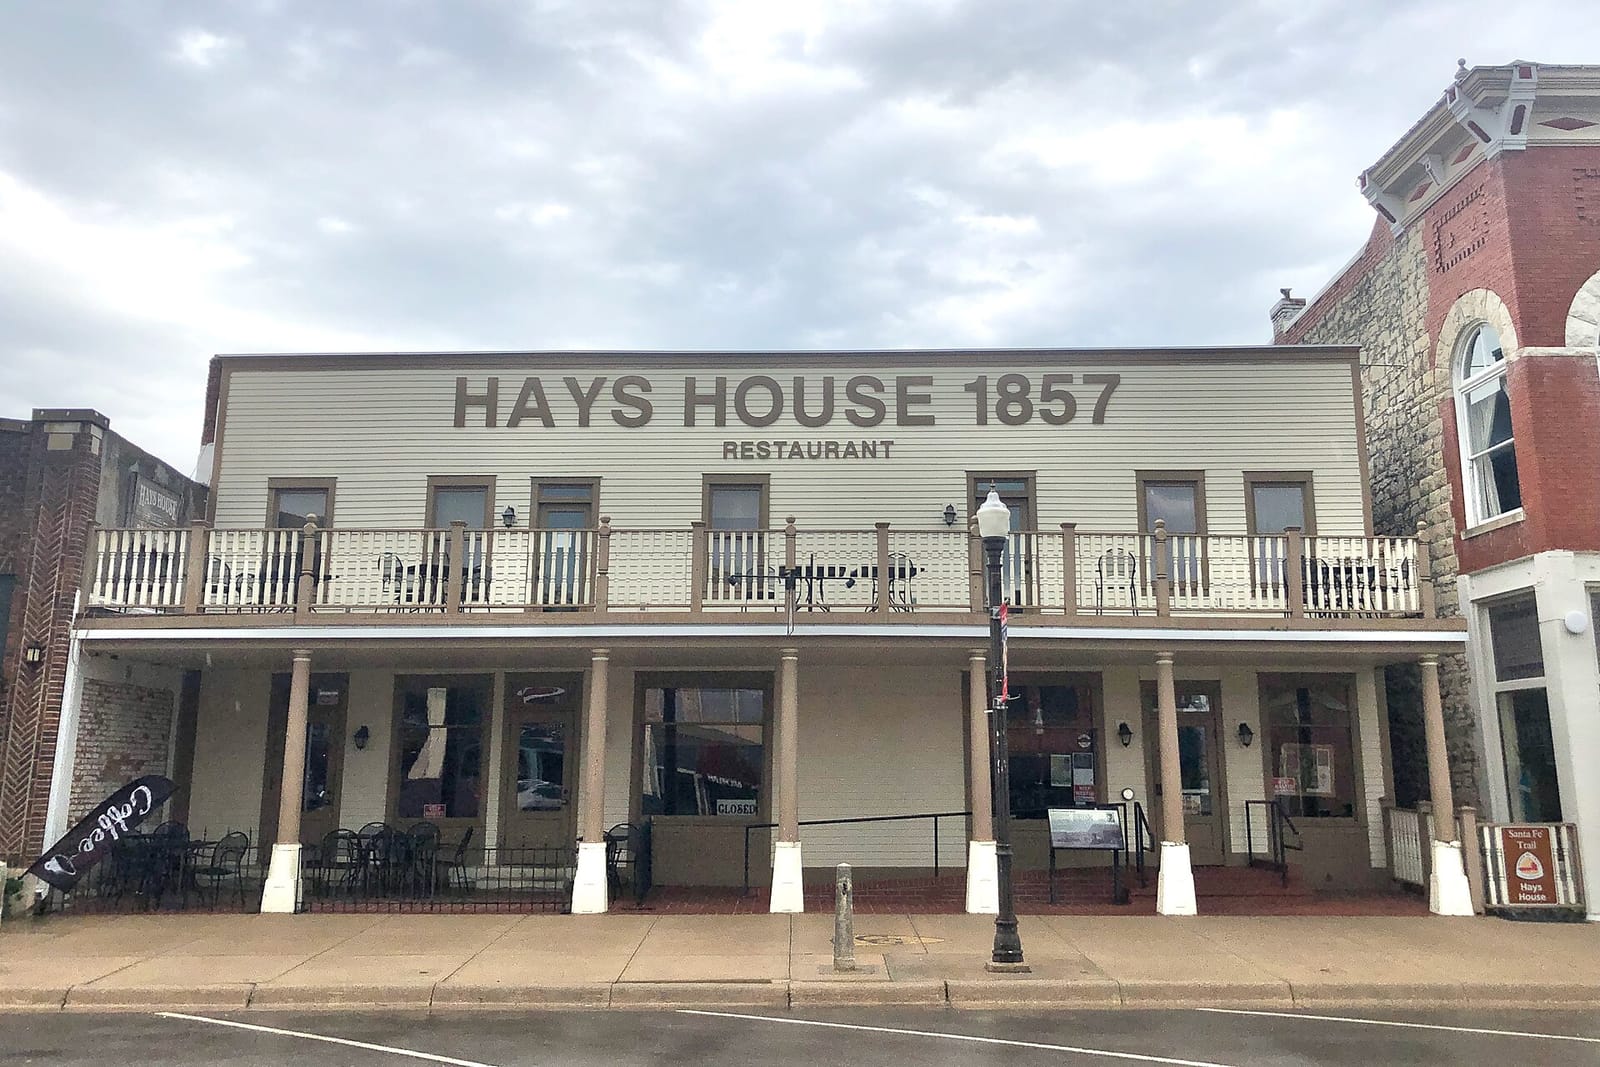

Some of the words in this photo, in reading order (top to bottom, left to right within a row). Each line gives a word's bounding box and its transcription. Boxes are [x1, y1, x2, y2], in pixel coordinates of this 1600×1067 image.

[453, 375, 654, 427] HAYS
[683, 375, 936, 427] HOUSE
[964, 373, 1121, 425] 1857
[723, 440, 895, 459] RESTAURANT
[139, 485, 157, 506] HAYS
[157, 493, 178, 521] HOUSE
[718, 803, 757, 814] CLOSED
[78, 785, 152, 852] Coffee
[1508, 830, 1531, 838] Santa
[1517, 841, 1537, 849] Trail
[1520, 882, 1543, 892] Hays
[1518, 893, 1547, 901] House
